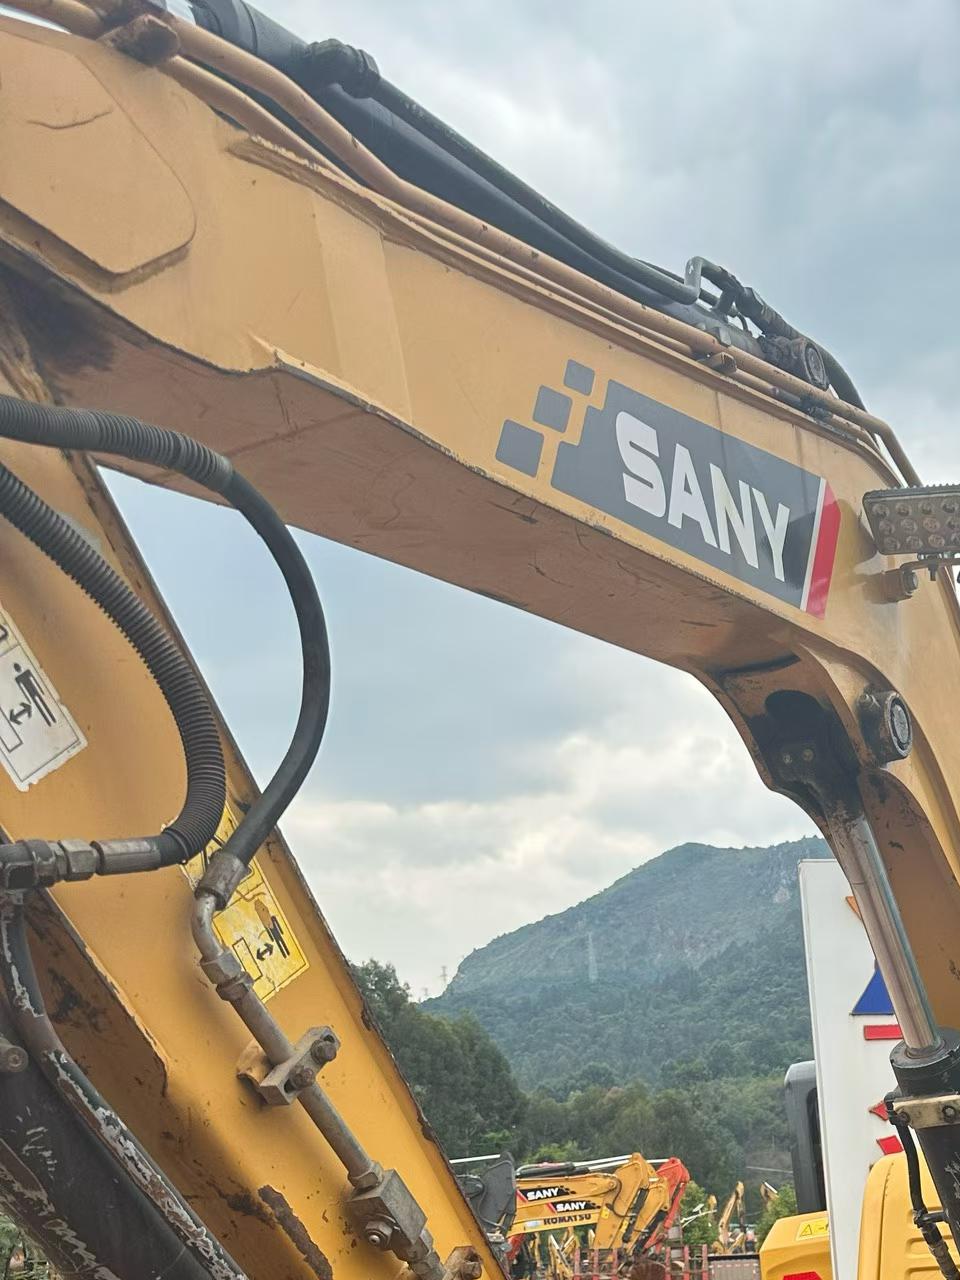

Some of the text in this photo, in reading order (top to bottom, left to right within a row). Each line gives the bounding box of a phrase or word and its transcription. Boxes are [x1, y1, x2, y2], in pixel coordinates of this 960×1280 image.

[616, 410, 790, 582] SANY
[526, 1187, 559, 1201] SANY
[556, 1201, 586, 1212] SANY
[543, 1213, 591, 1225] KOMATSU
